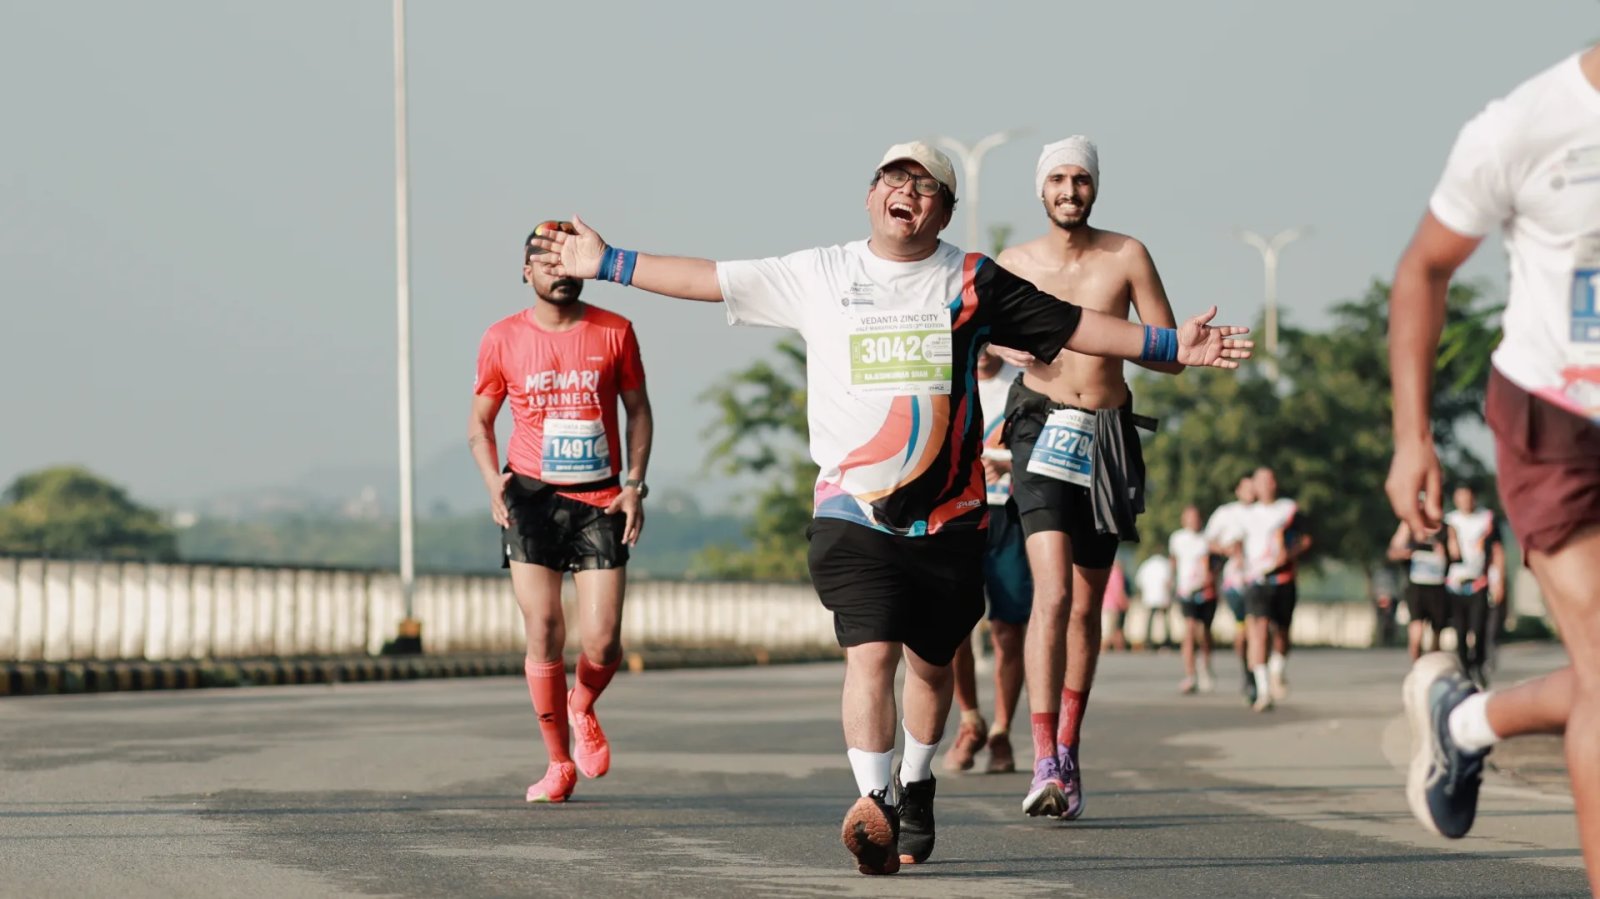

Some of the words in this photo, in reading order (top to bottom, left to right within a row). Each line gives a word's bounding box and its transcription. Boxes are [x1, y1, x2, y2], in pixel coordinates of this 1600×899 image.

[861, 316, 898, 325] VEDANTA
[900, 314, 919, 323] ZINC
[921, 314, 938, 322] CITY
[861, 335, 922, 364] 3042
[525, 369, 600, 394] MEWARI
[528, 393, 600, 408] RUNNERS
[552, 438, 593, 458] 1491
[1046, 428, 1089, 457] 1279
